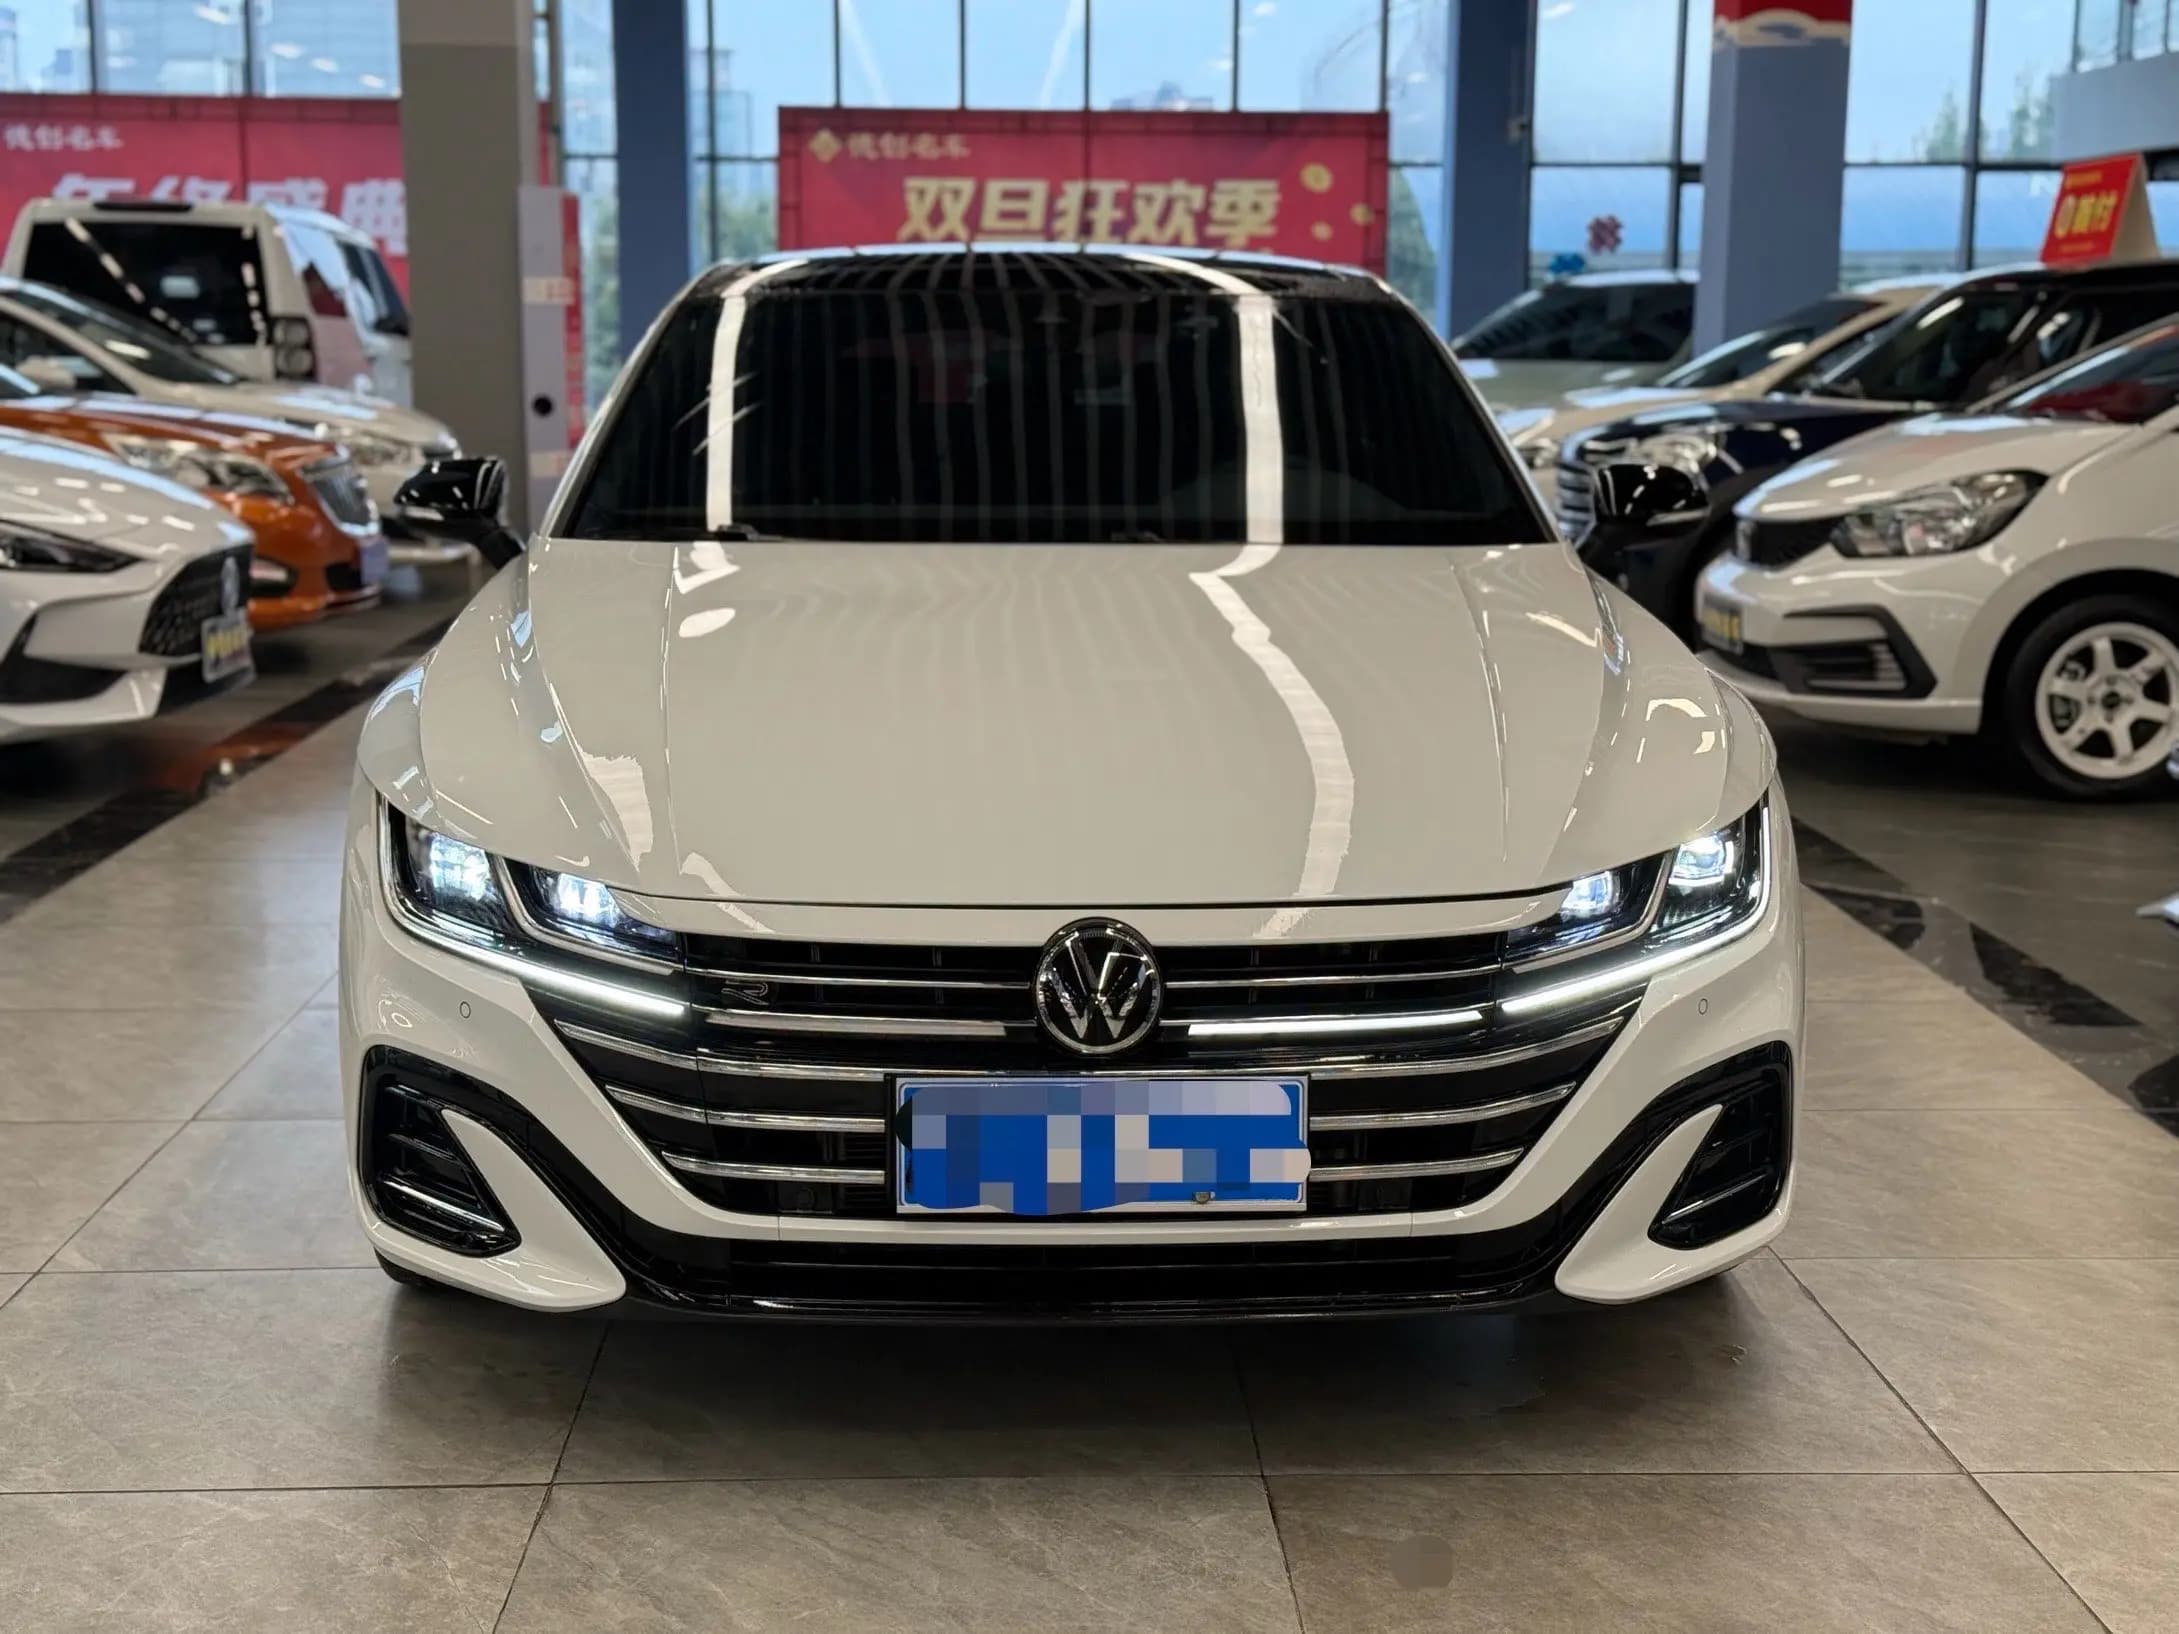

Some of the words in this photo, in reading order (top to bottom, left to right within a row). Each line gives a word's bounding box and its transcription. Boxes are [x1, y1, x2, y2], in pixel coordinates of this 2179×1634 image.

[898, 176, 1281, 248] 双旦狂欢季
